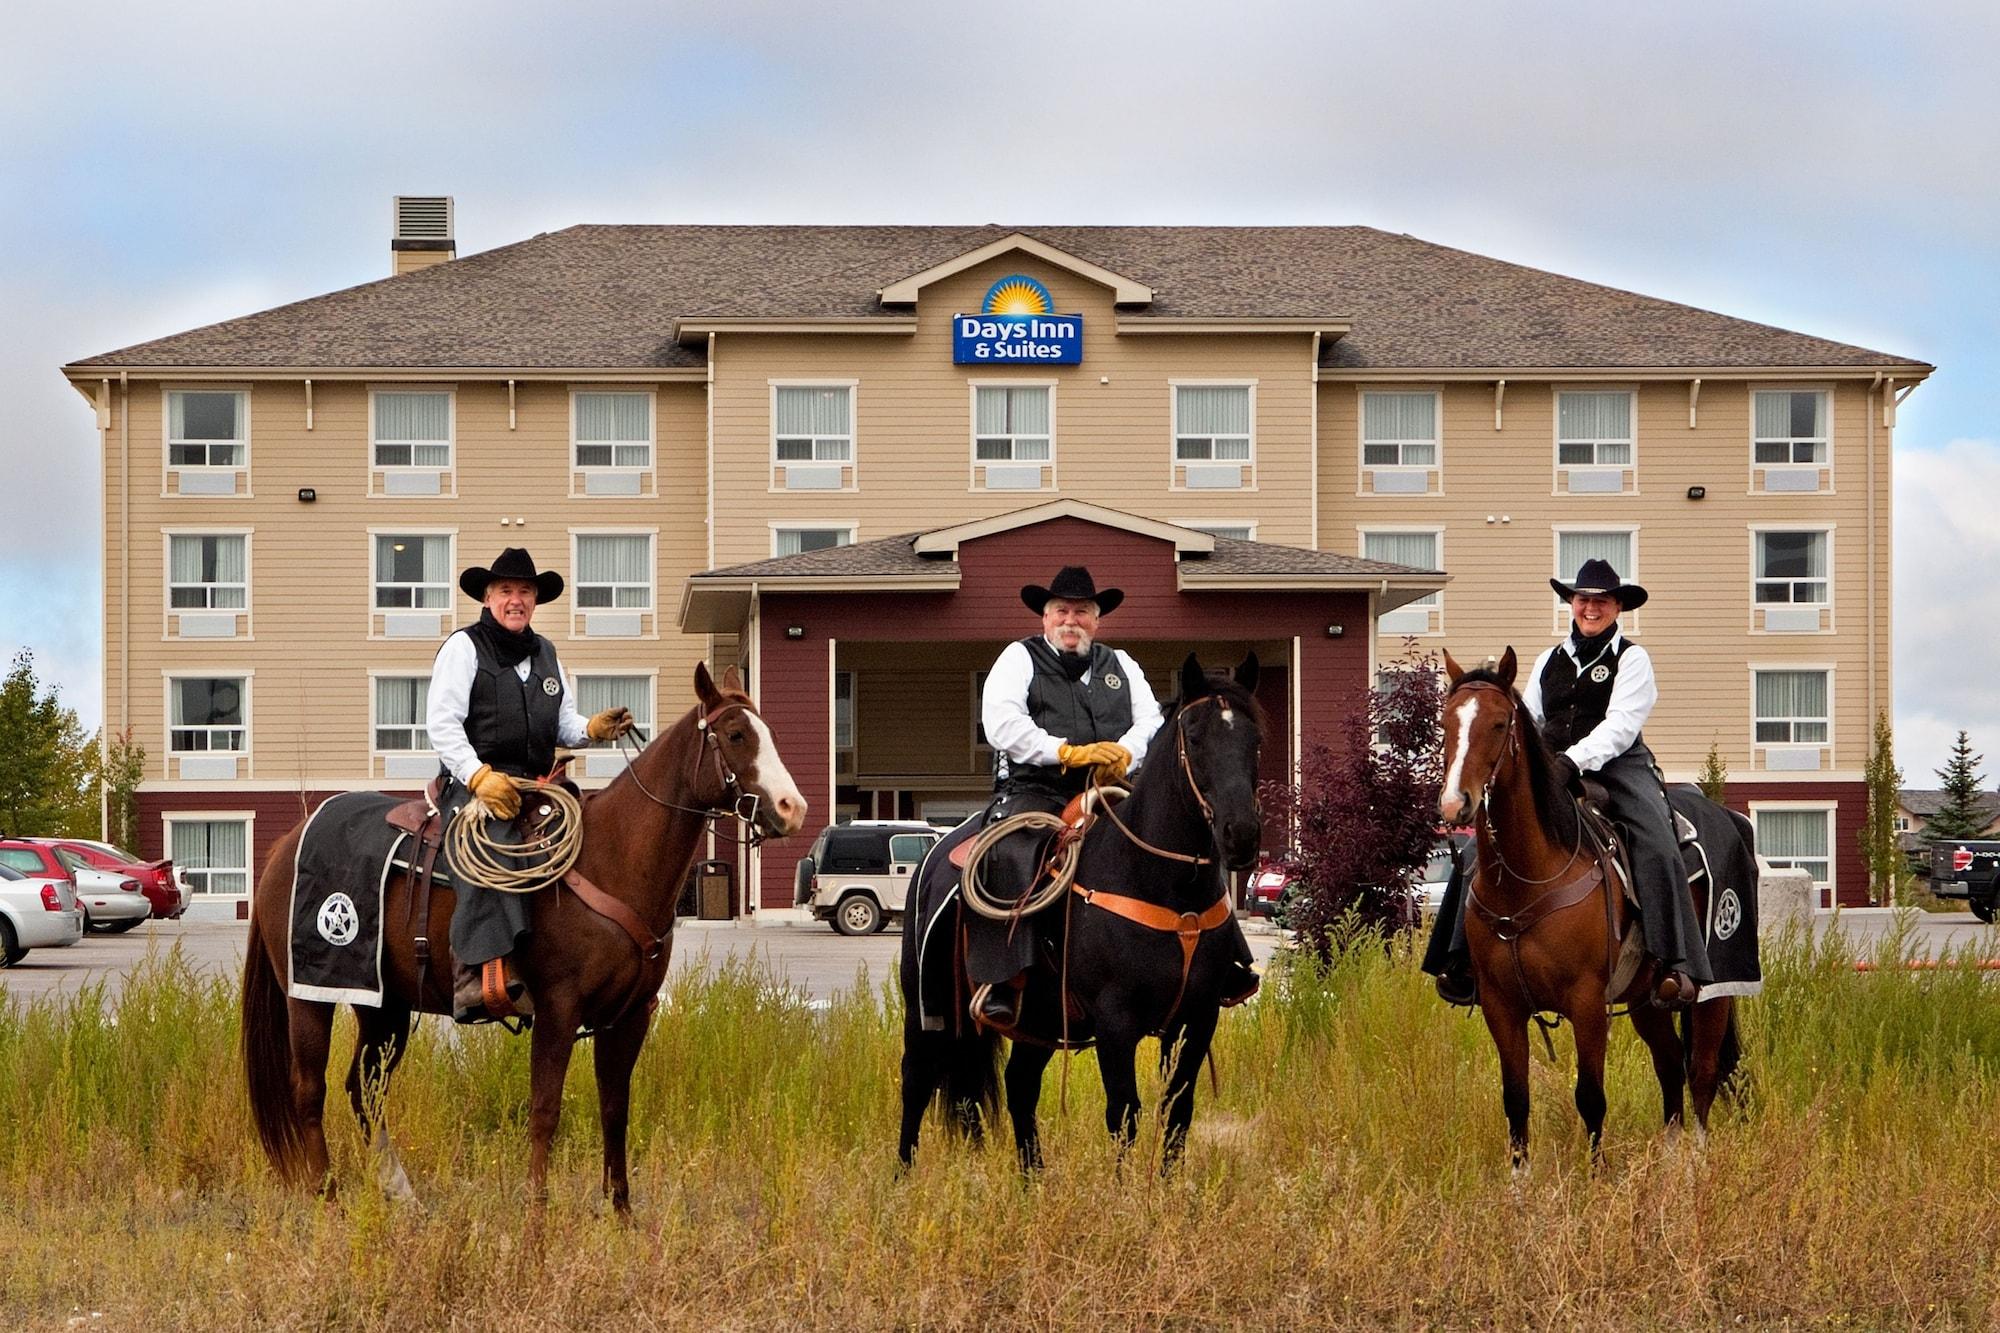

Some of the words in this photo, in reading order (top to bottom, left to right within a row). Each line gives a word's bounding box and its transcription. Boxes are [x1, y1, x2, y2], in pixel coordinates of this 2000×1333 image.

[962, 319, 1027, 340] Days
[1031, 319, 1074, 338] Inn
[975, 342, 990, 358] &
[994, 340, 1062, 358] Suites
